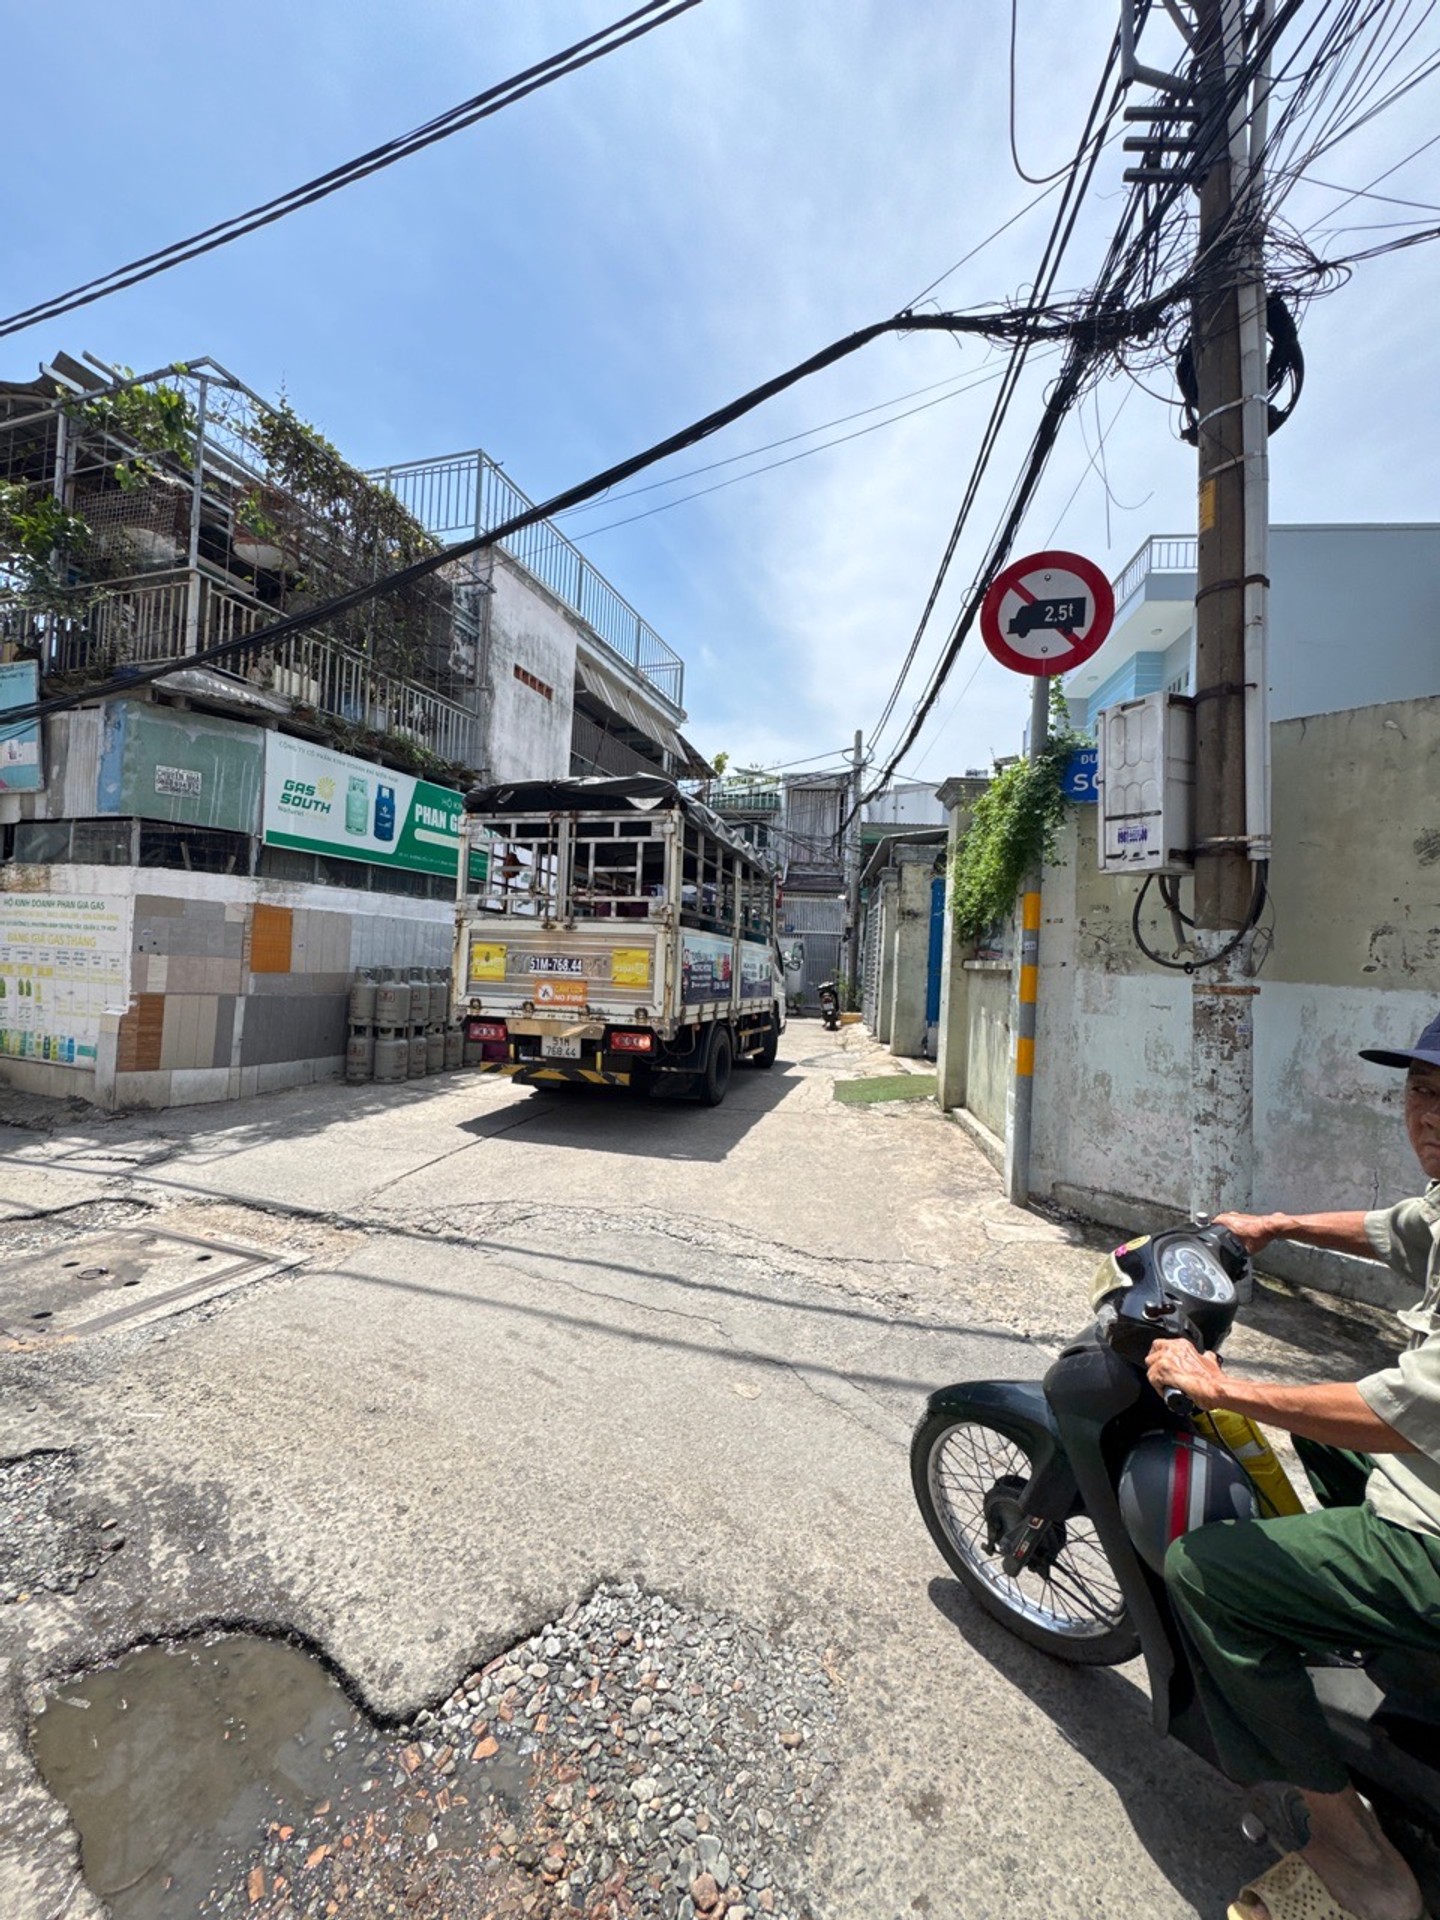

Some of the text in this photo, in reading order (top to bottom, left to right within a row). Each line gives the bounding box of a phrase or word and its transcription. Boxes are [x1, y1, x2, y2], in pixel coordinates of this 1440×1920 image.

[283, 779, 316, 797] GAS
[279, 793, 331, 814] SOUTH
[415, 804, 447, 830] PHAN
[31, 899, 55, 908] DOANH
[57, 901, 76, 910] PHAN
[91, 901, 105, 911] GAS
[529, 957, 582, 972] 51M-768.44
